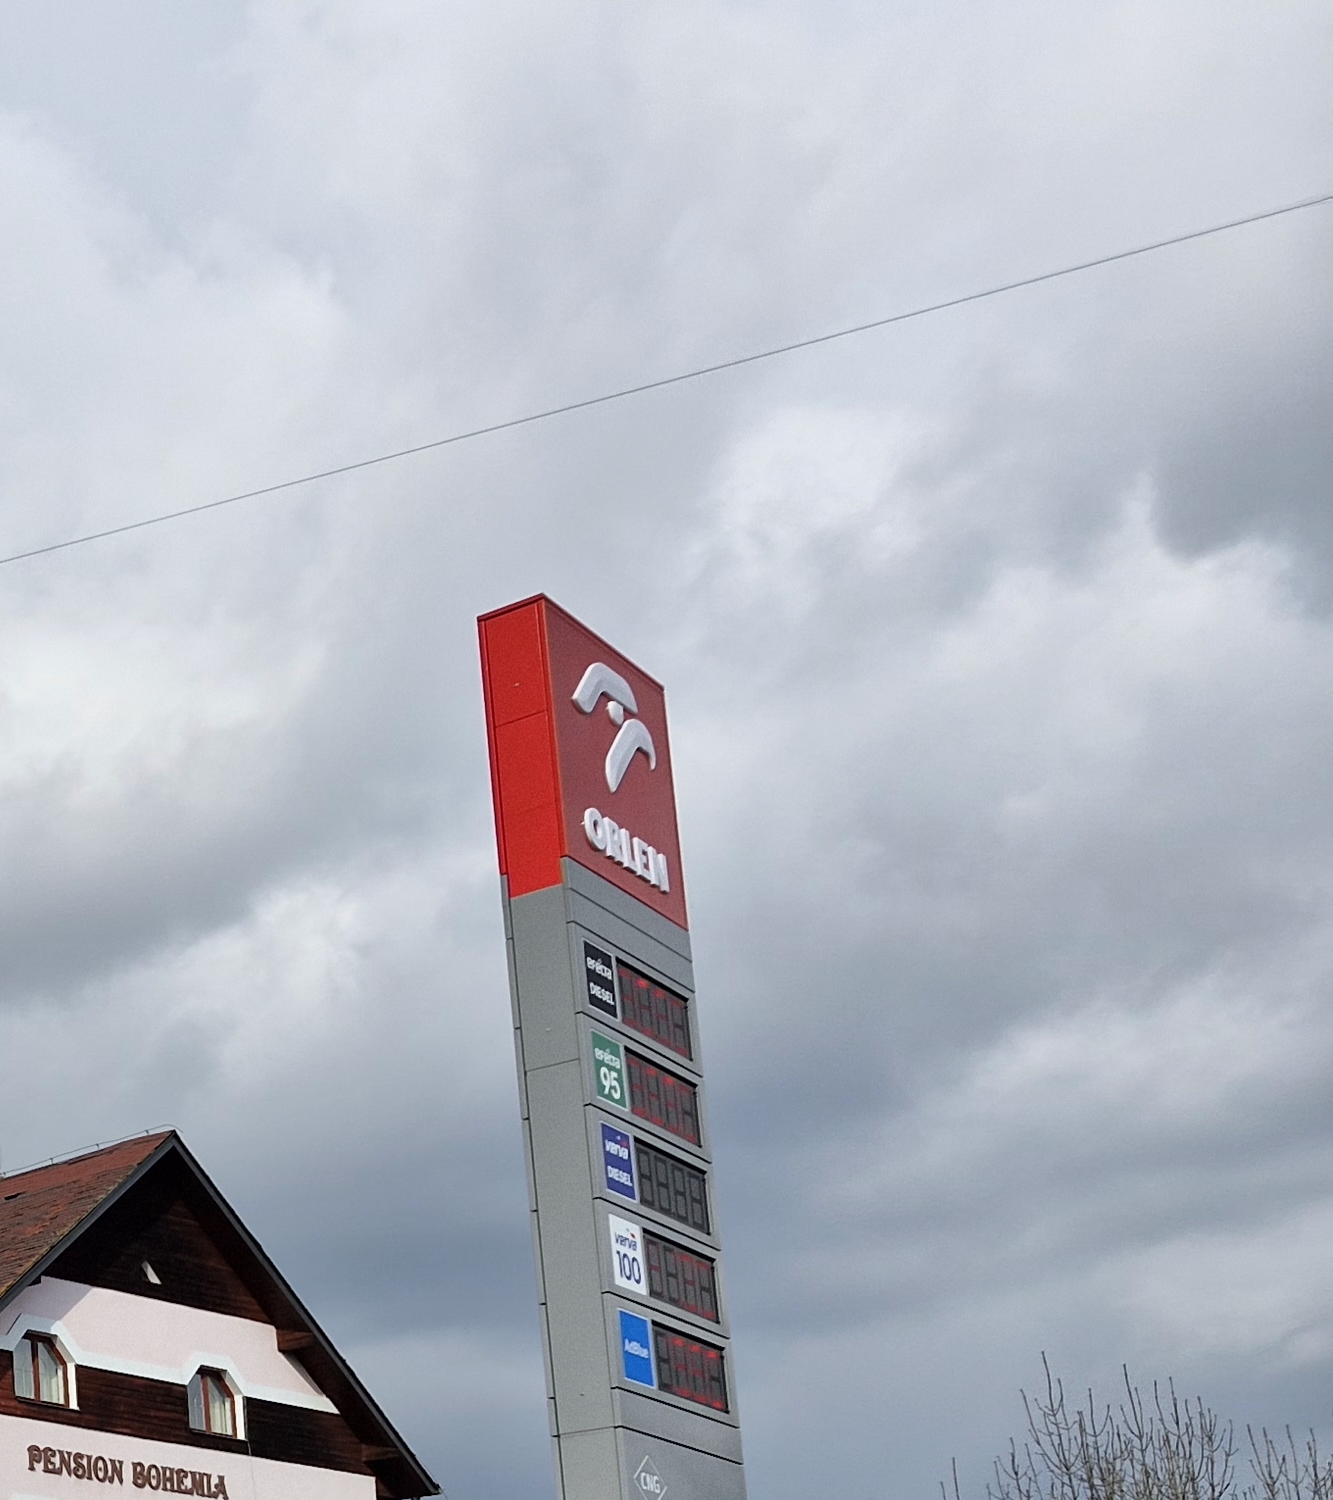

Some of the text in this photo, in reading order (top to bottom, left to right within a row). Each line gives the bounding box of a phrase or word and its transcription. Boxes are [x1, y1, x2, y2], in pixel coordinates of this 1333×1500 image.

[583, 807, 670, 893] ORLEN
[589, 982, 615, 1006] DIESEL
[599, 1066, 621, 1100] 95
[605, 1139, 630, 1160] verva
[607, 1165, 633, 1187] DIESEL
[614, 1232, 637, 1252] verva
[616, 1249, 642, 1285] 100
[27, 1444, 229, 1500] PENSION BOHEMIA
[640, 1472, 661, 1494] CNG
